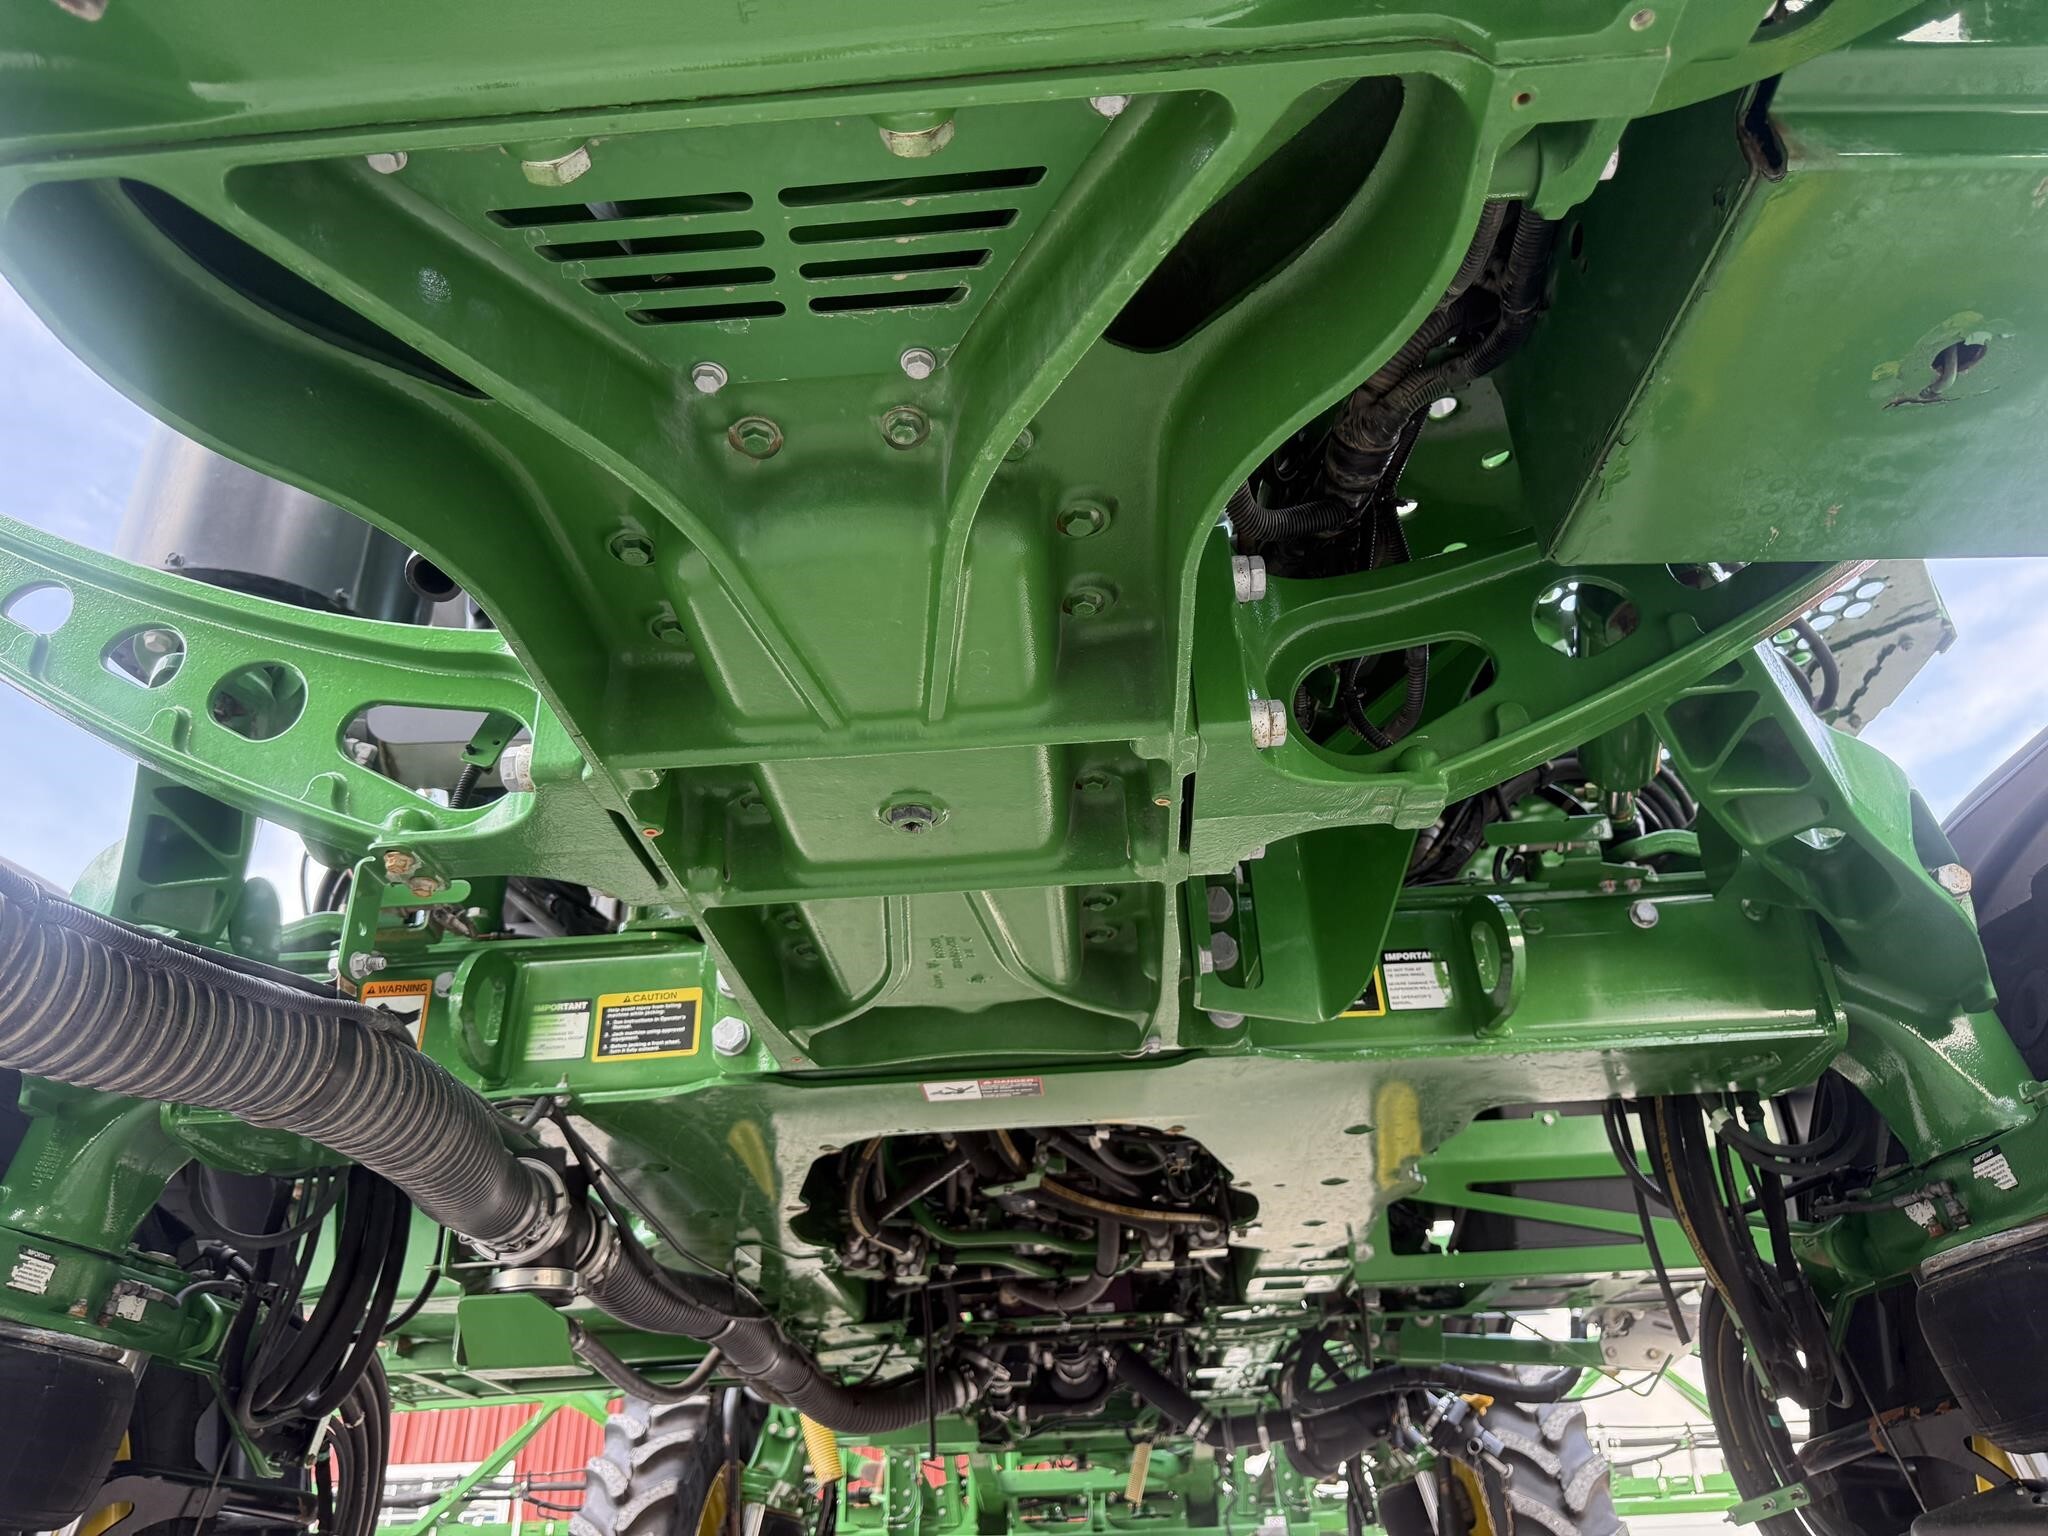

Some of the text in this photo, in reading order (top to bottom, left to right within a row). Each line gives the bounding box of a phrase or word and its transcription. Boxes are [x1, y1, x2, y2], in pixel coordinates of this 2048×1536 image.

[378, 983, 428, 994] WARNING
[633, 992, 677, 1002] CAUTION
[534, 1002, 588, 1012] IMPORTANT
